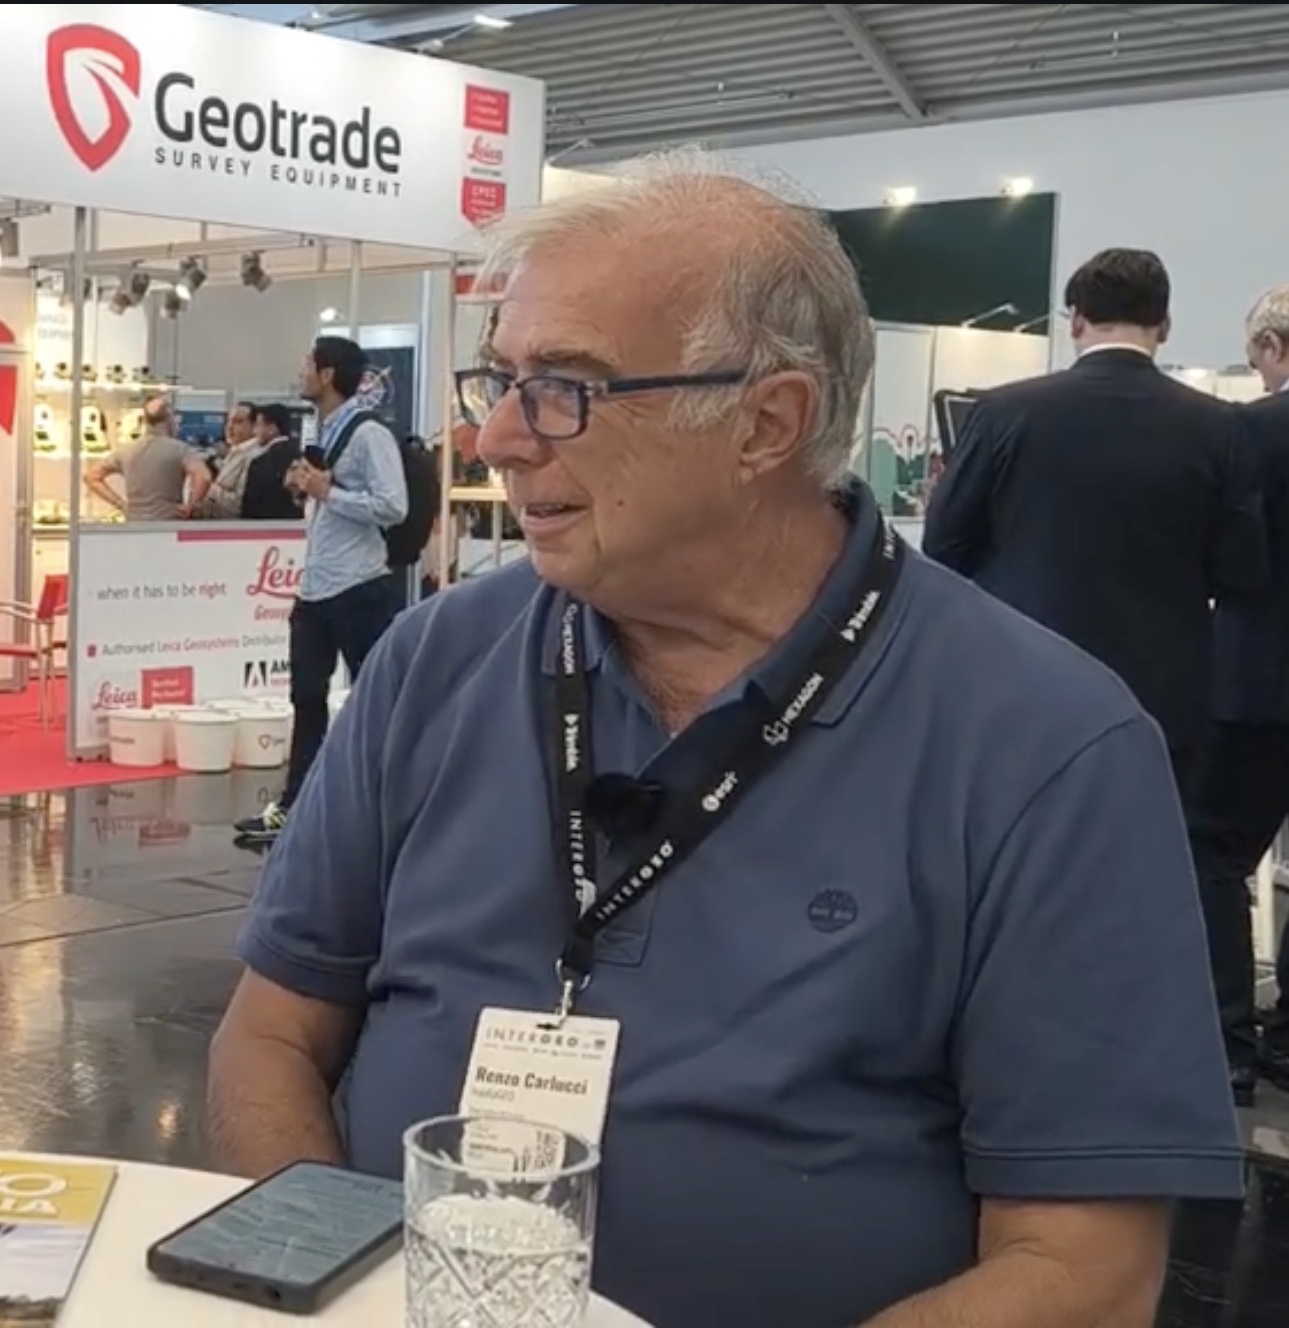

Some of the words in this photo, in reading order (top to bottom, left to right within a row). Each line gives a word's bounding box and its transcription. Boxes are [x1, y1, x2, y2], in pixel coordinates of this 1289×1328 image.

[154, 71, 402, 174] Geotrade
[467, 135, 503, 165] Leica
[155, 146, 251, 176] SURVEY
[270, 164, 402, 198] EQUIPMENT
[97, 586, 130, 600] when
[132, 585, 141, 599] it
[143, 583, 164, 598] has
[166, 584, 179, 597] to
[182, 582, 196, 597] be
[199, 580, 227, 599] right
[157, 639, 181, 653] Leica
[92, 682, 138, 710] Leica
[781, 672, 824, 725] HEXAGON
[485, 1027, 579, 1048] INTERGEO
[475, 1066, 520, 1087] Renzo
[524, 1071, 589, 1096] Carlucci
